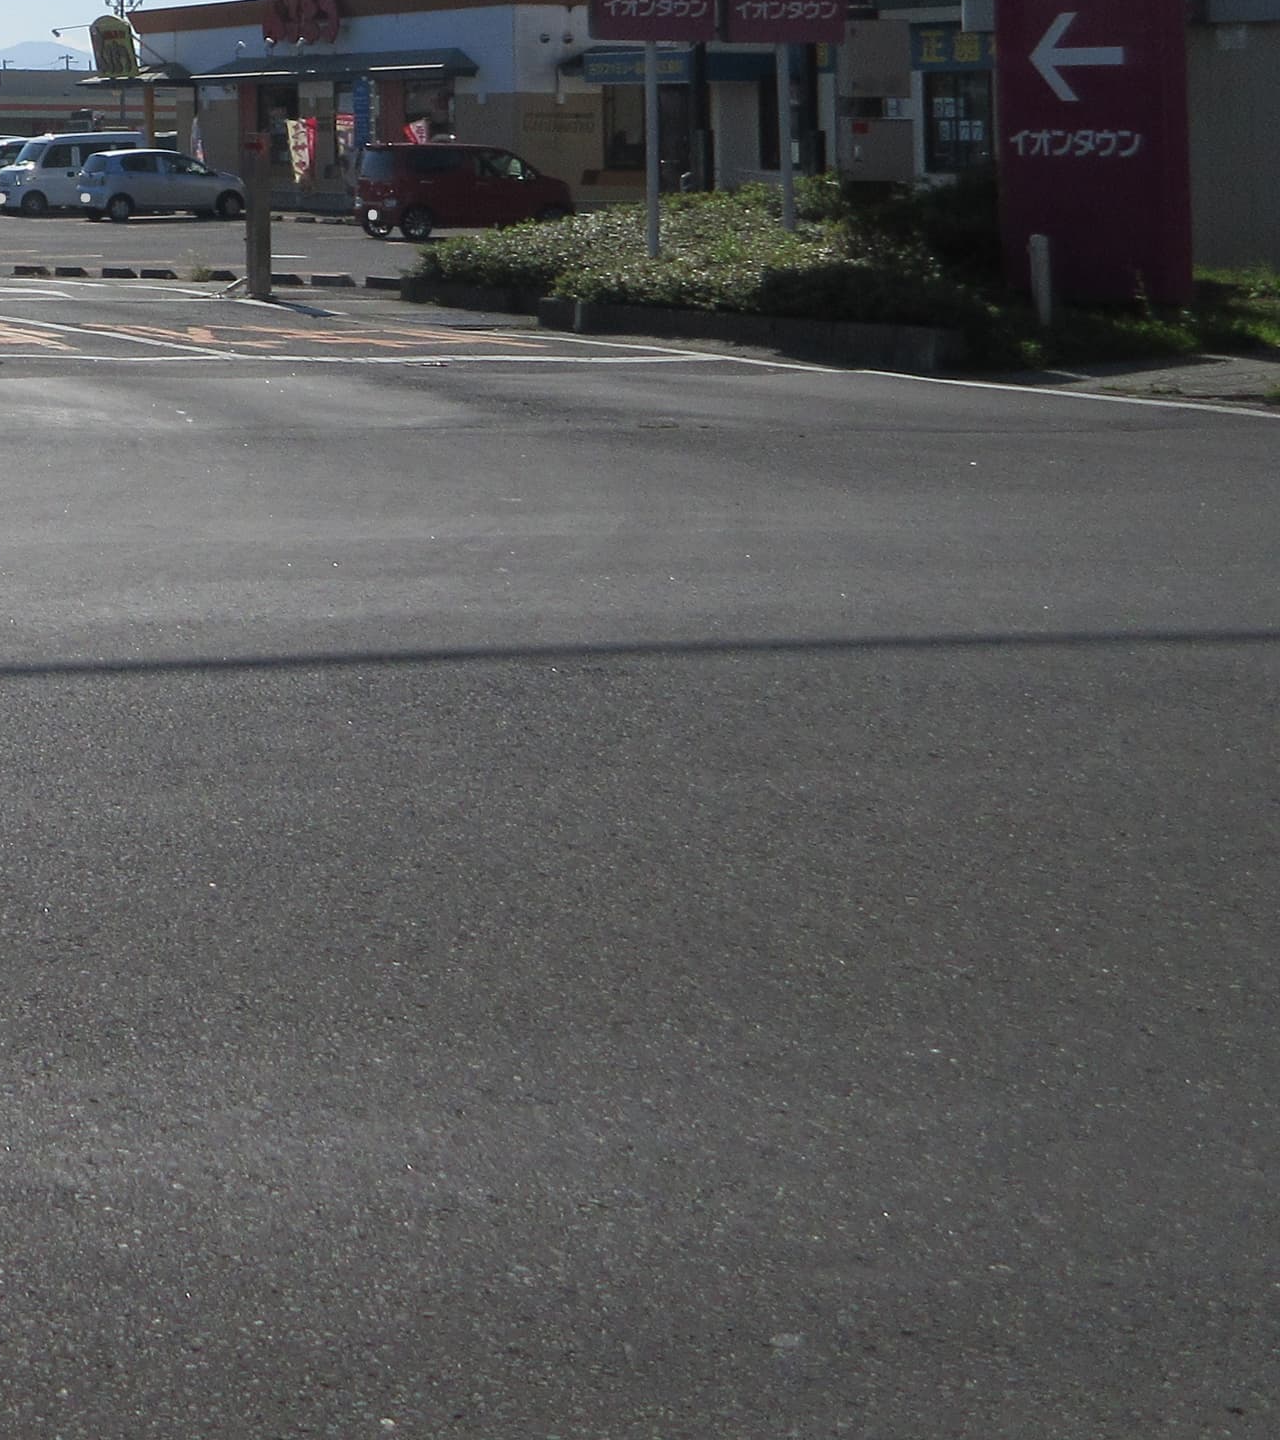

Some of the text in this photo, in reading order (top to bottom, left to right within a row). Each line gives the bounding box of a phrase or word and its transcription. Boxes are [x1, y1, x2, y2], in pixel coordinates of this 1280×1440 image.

[735, 1, 838, 21] イオンタウン
[1009, 129, 1142, 158] イオンタウン
